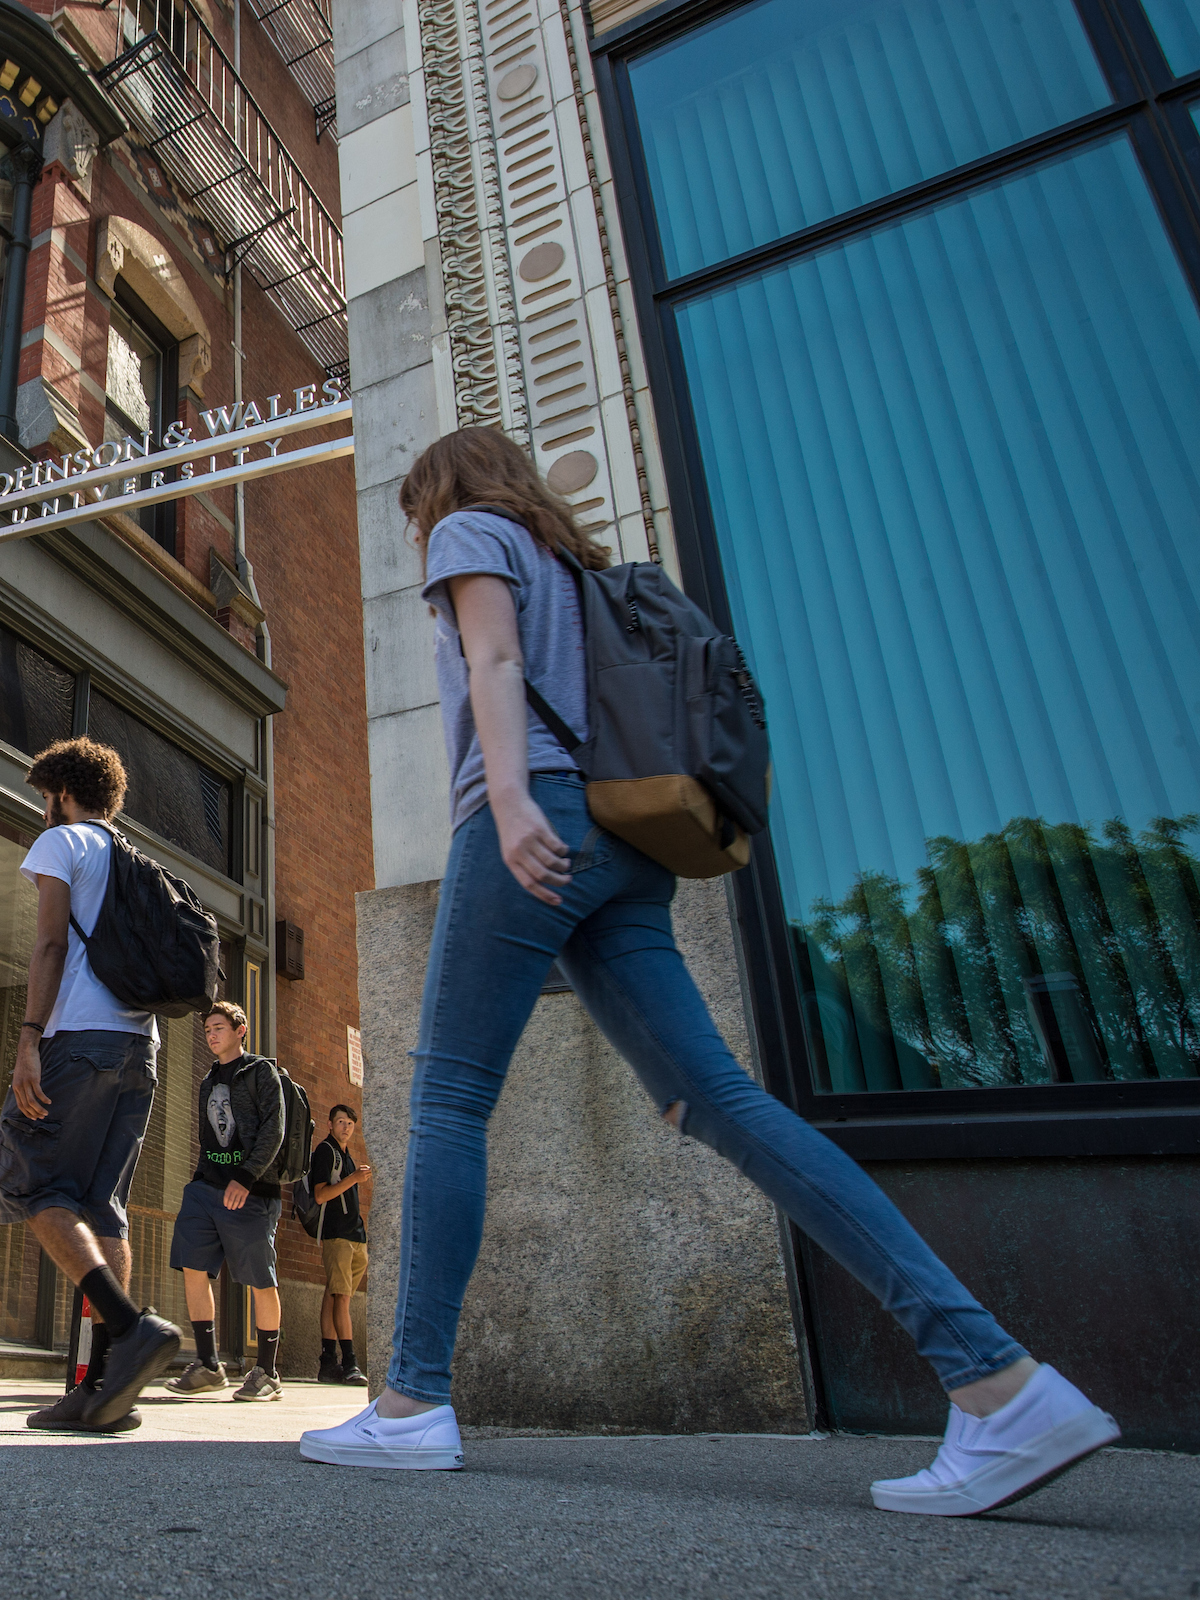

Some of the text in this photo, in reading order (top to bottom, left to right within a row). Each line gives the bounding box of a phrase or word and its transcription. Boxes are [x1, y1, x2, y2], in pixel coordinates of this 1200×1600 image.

[162, 420, 196, 449] &
[199, 376, 347, 438] WALES
[12, 437, 283, 525] UNIVERSITY
